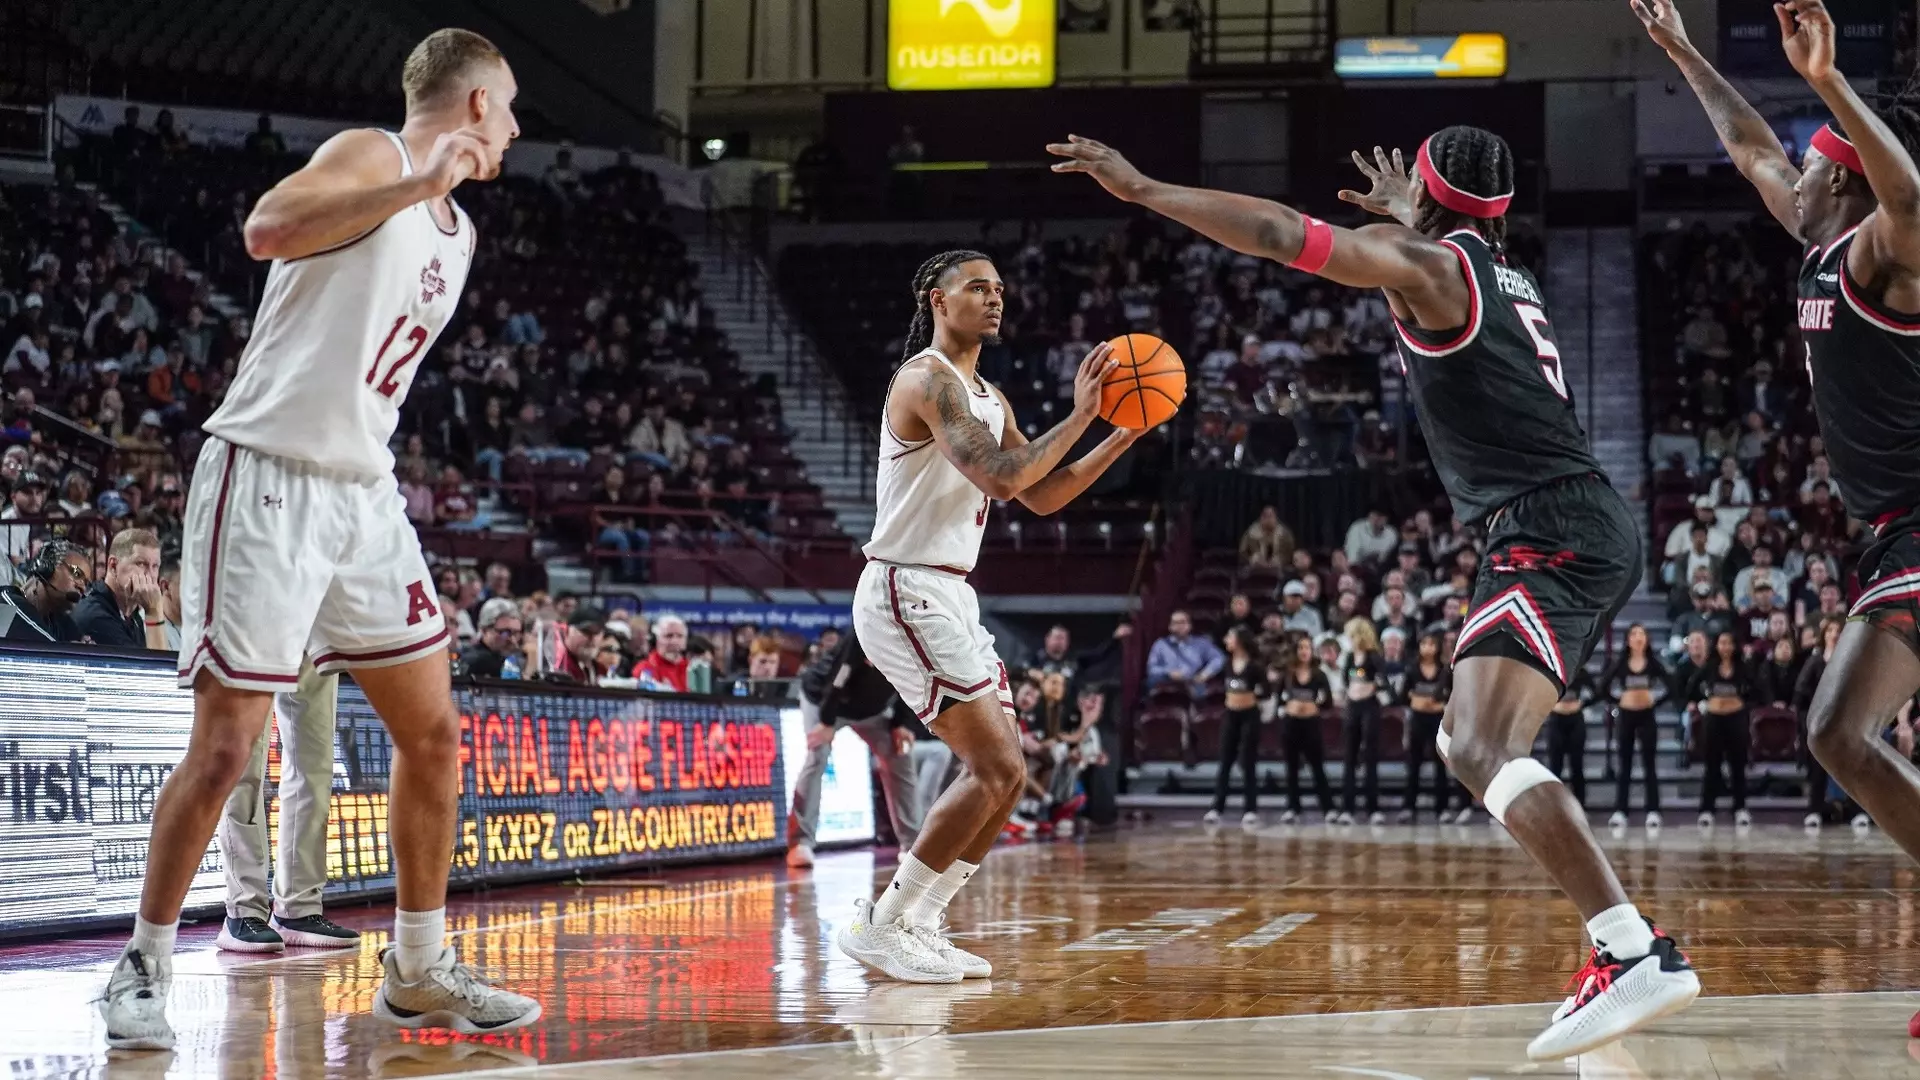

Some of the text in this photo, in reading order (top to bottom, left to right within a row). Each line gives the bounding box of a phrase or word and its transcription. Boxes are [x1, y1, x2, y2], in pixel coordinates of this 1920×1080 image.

[1799, 298, 1836, 330] STATE
[366, 315, 428, 398] 12
[1513, 302, 1569, 400] 5
[406, 580, 438, 627] A
[568, 718, 656, 793] AGGIE
[659, 720, 777, 791] FLAGSHIP
[450, 818, 480, 869] .5
[485, 812, 560, 864] KXPZ
[563, 822, 592, 859] OR
[592, 801, 777, 857] ZIACOUNTRY.COM
